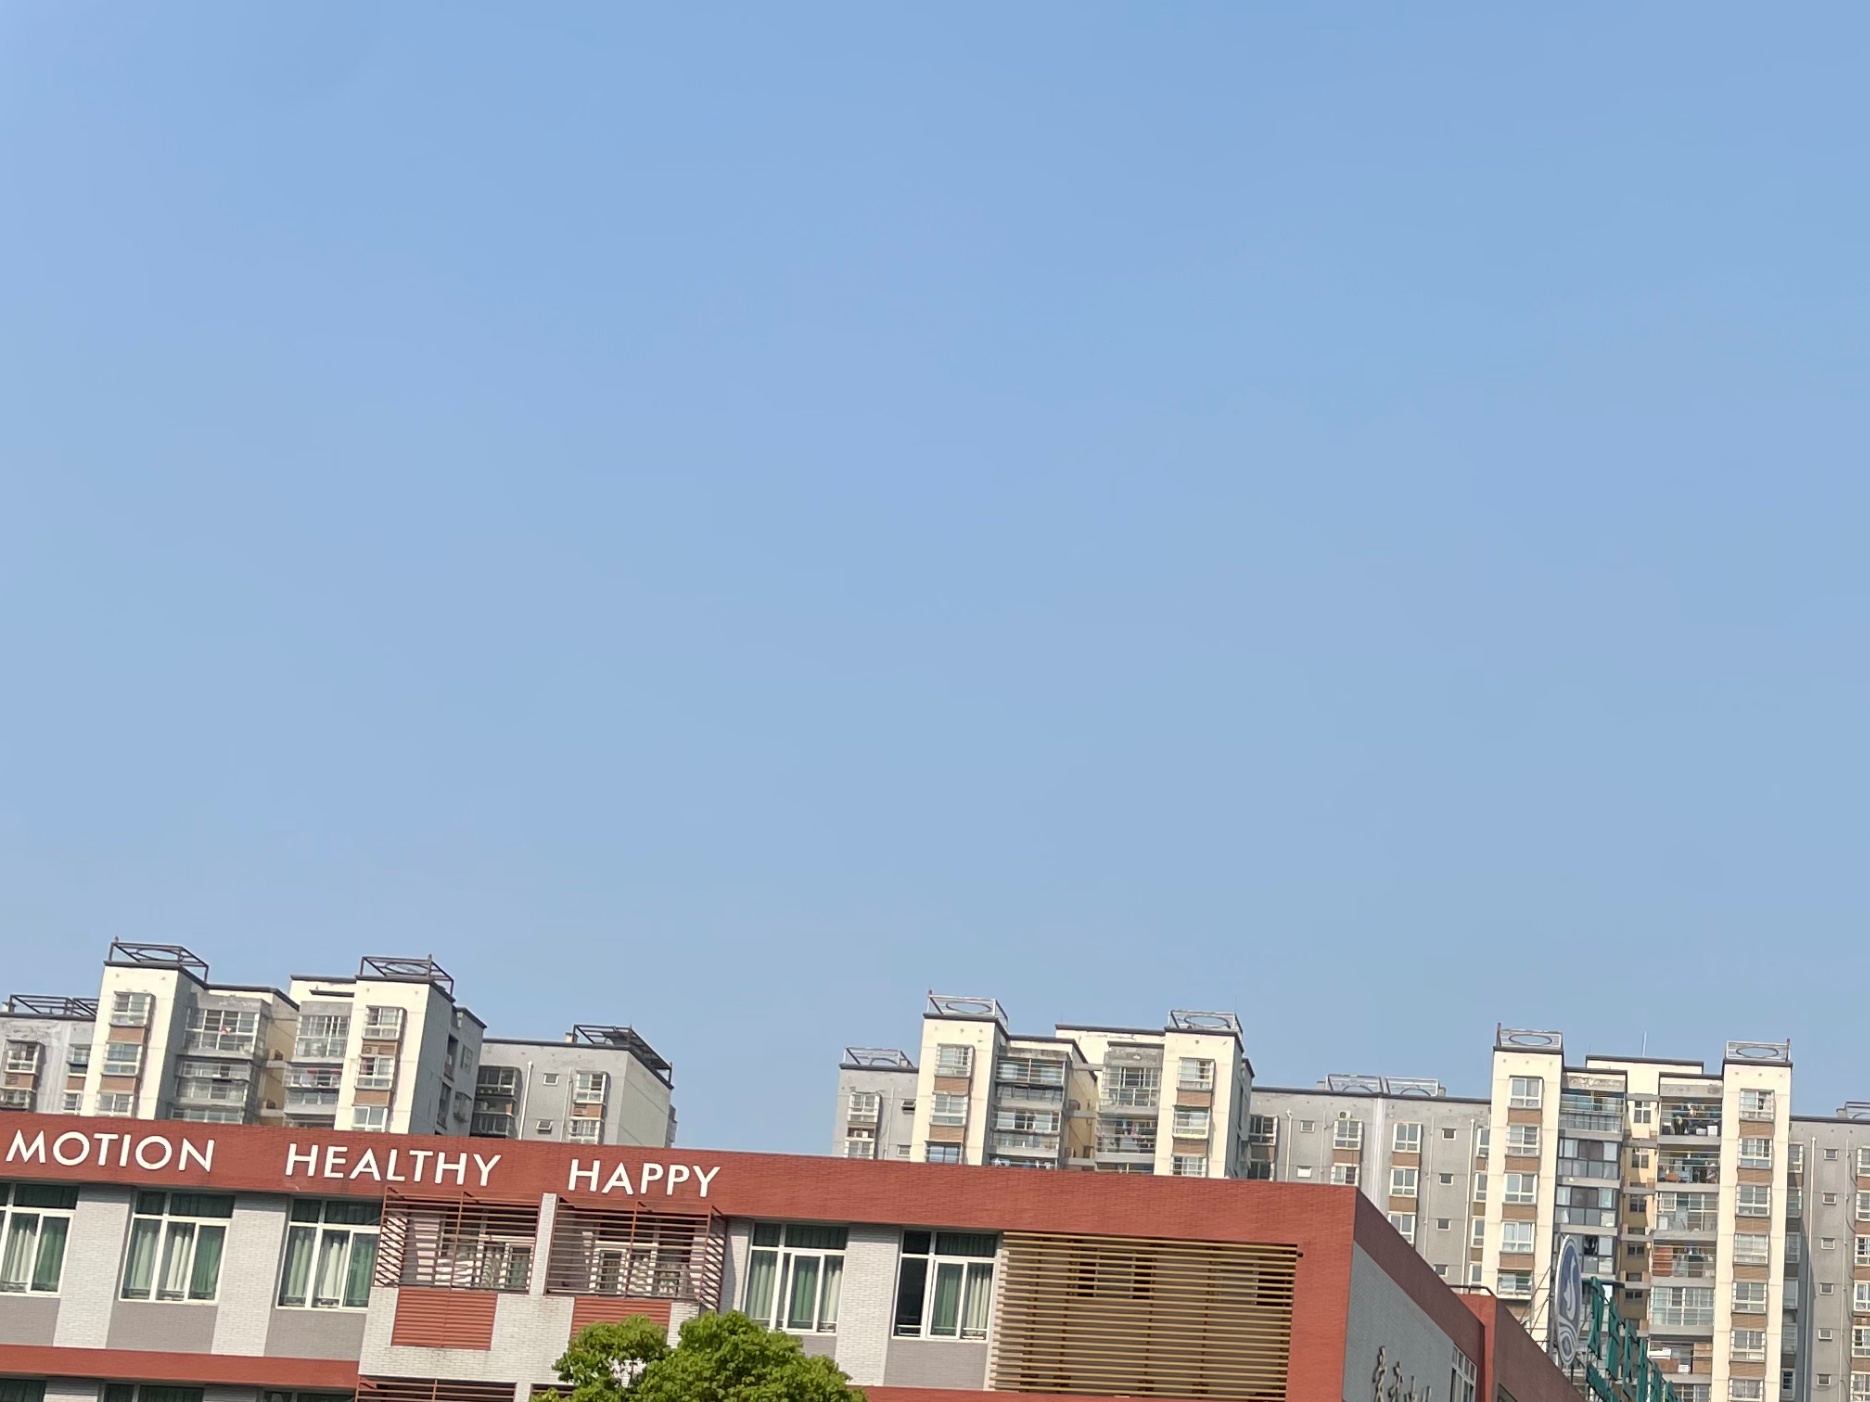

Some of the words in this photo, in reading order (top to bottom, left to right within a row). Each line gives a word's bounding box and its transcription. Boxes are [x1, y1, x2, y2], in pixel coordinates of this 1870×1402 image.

[5, 1129, 216, 1172] MOTION
[285, 1143, 502, 1186] HEALTHY
[567, 1158, 721, 1197] HAPPY
